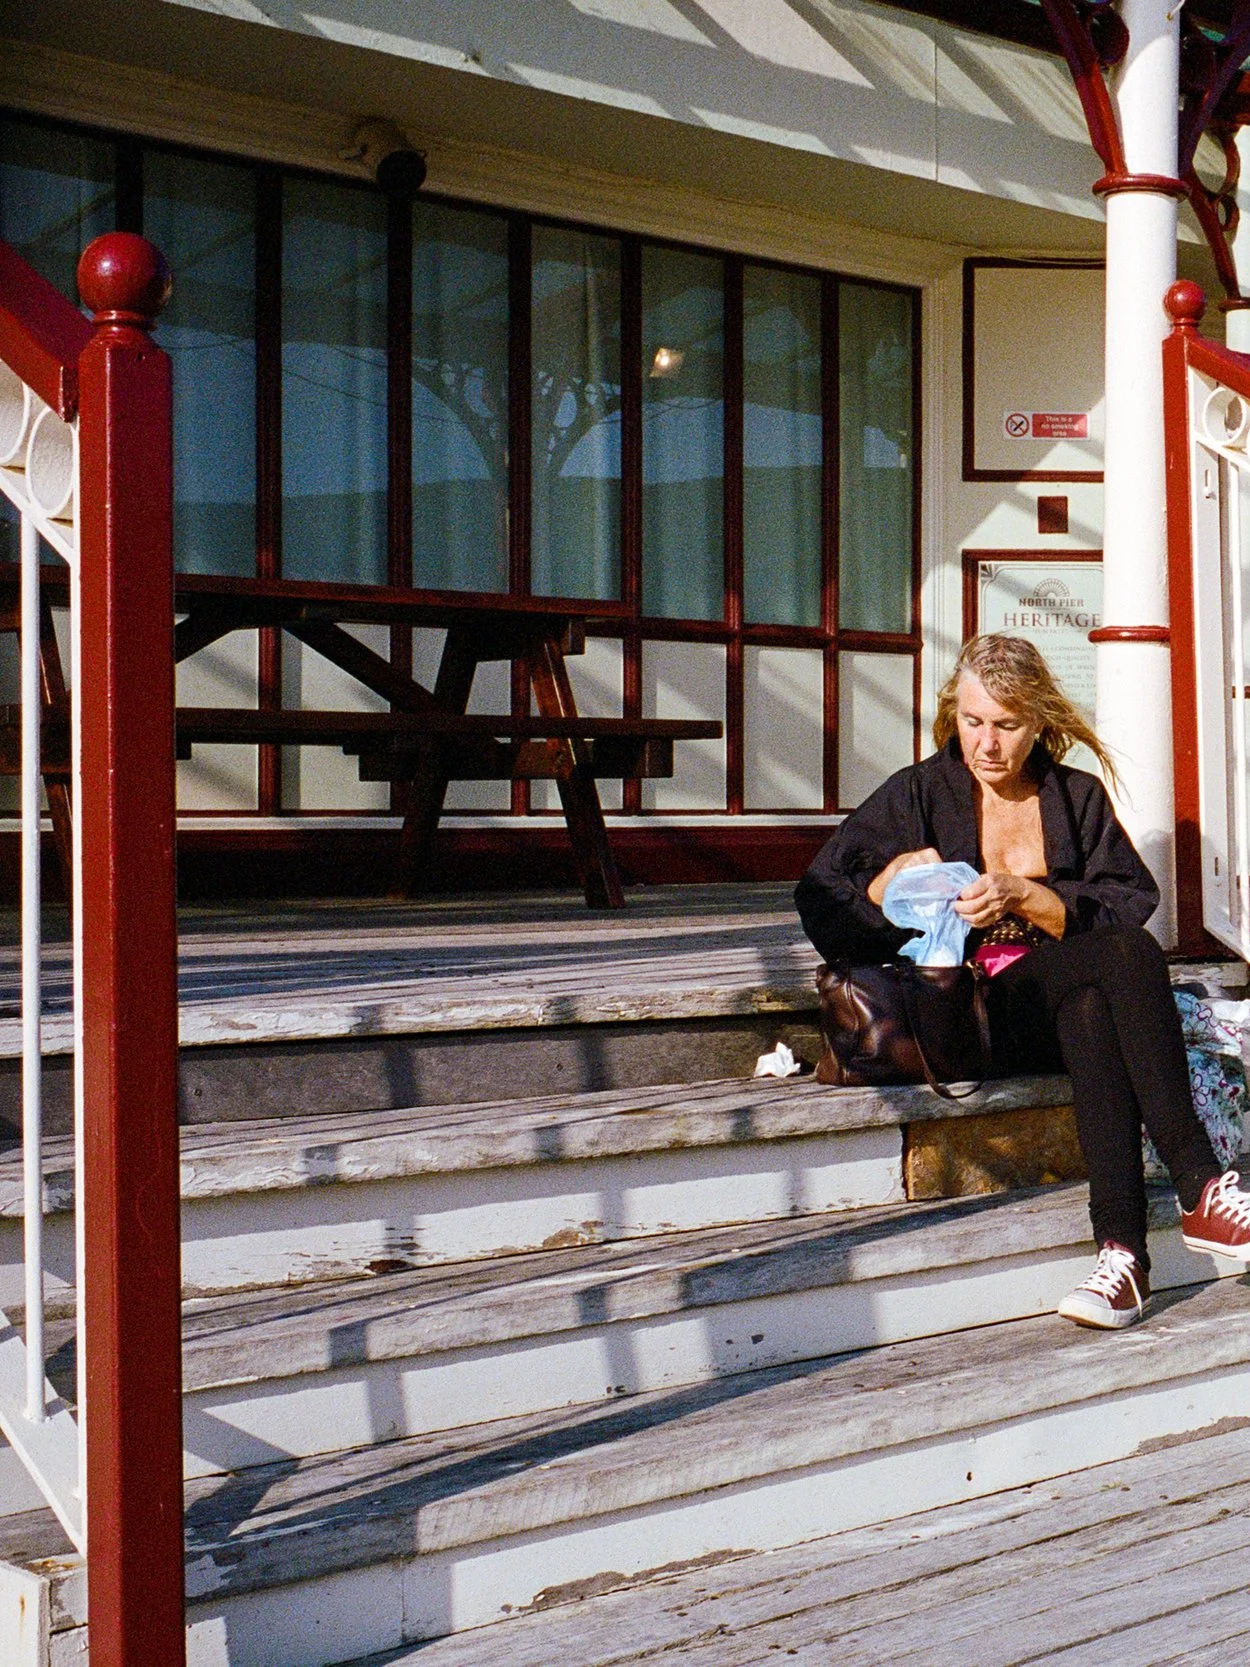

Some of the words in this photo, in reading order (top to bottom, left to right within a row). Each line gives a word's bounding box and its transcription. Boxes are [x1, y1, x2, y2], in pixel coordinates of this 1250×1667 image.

[1050, 423, 1080, 431] smoking
[1019, 598, 1056, 607] NORTH
[1060, 599, 1084, 607] PIER
[1004, 613, 1101, 628] HERITAGE
